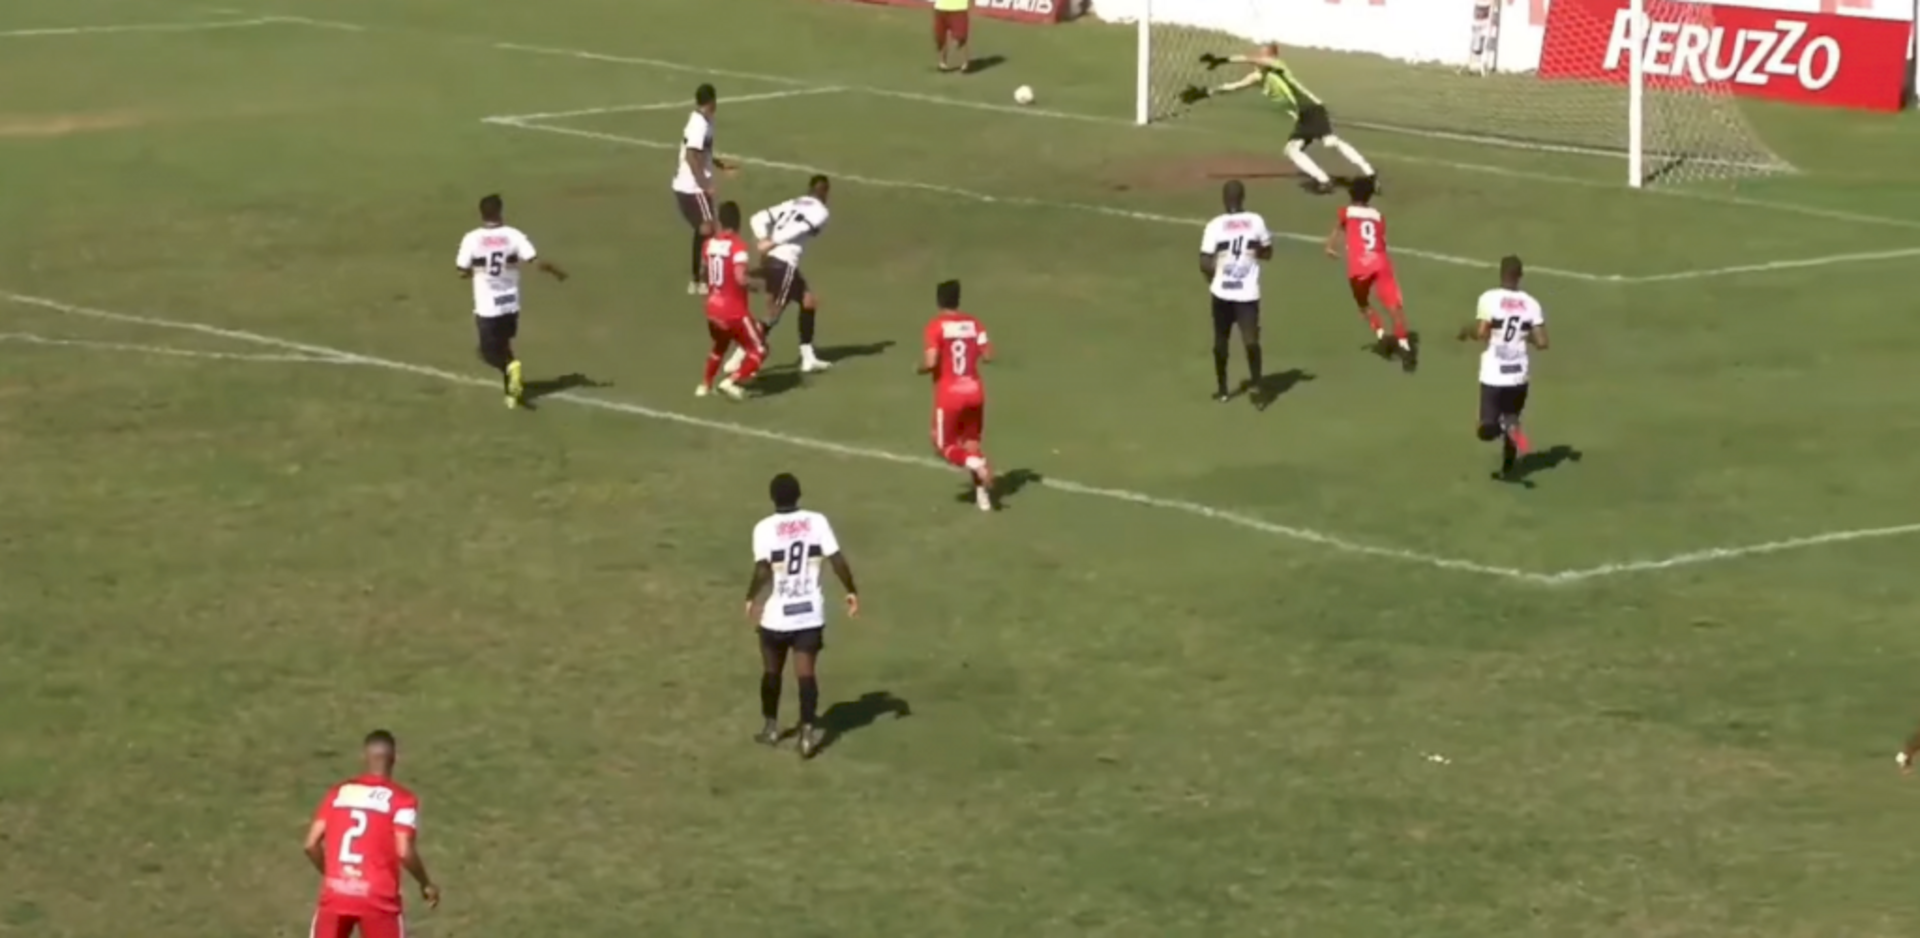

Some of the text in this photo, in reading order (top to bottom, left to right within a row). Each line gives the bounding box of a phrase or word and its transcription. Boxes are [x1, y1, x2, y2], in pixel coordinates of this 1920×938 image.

[1603, 9, 1841, 90] PERUZZO
[1232, 235, 1244, 261] 4
[1361, 220, 1377, 251] 9
[489, 251, 503, 277] 5
[1504, 315, 1520, 343] 6
[950, 340, 967, 376] 8
[787, 540, 804, 575] 8
[339, 808, 368, 864] 2
